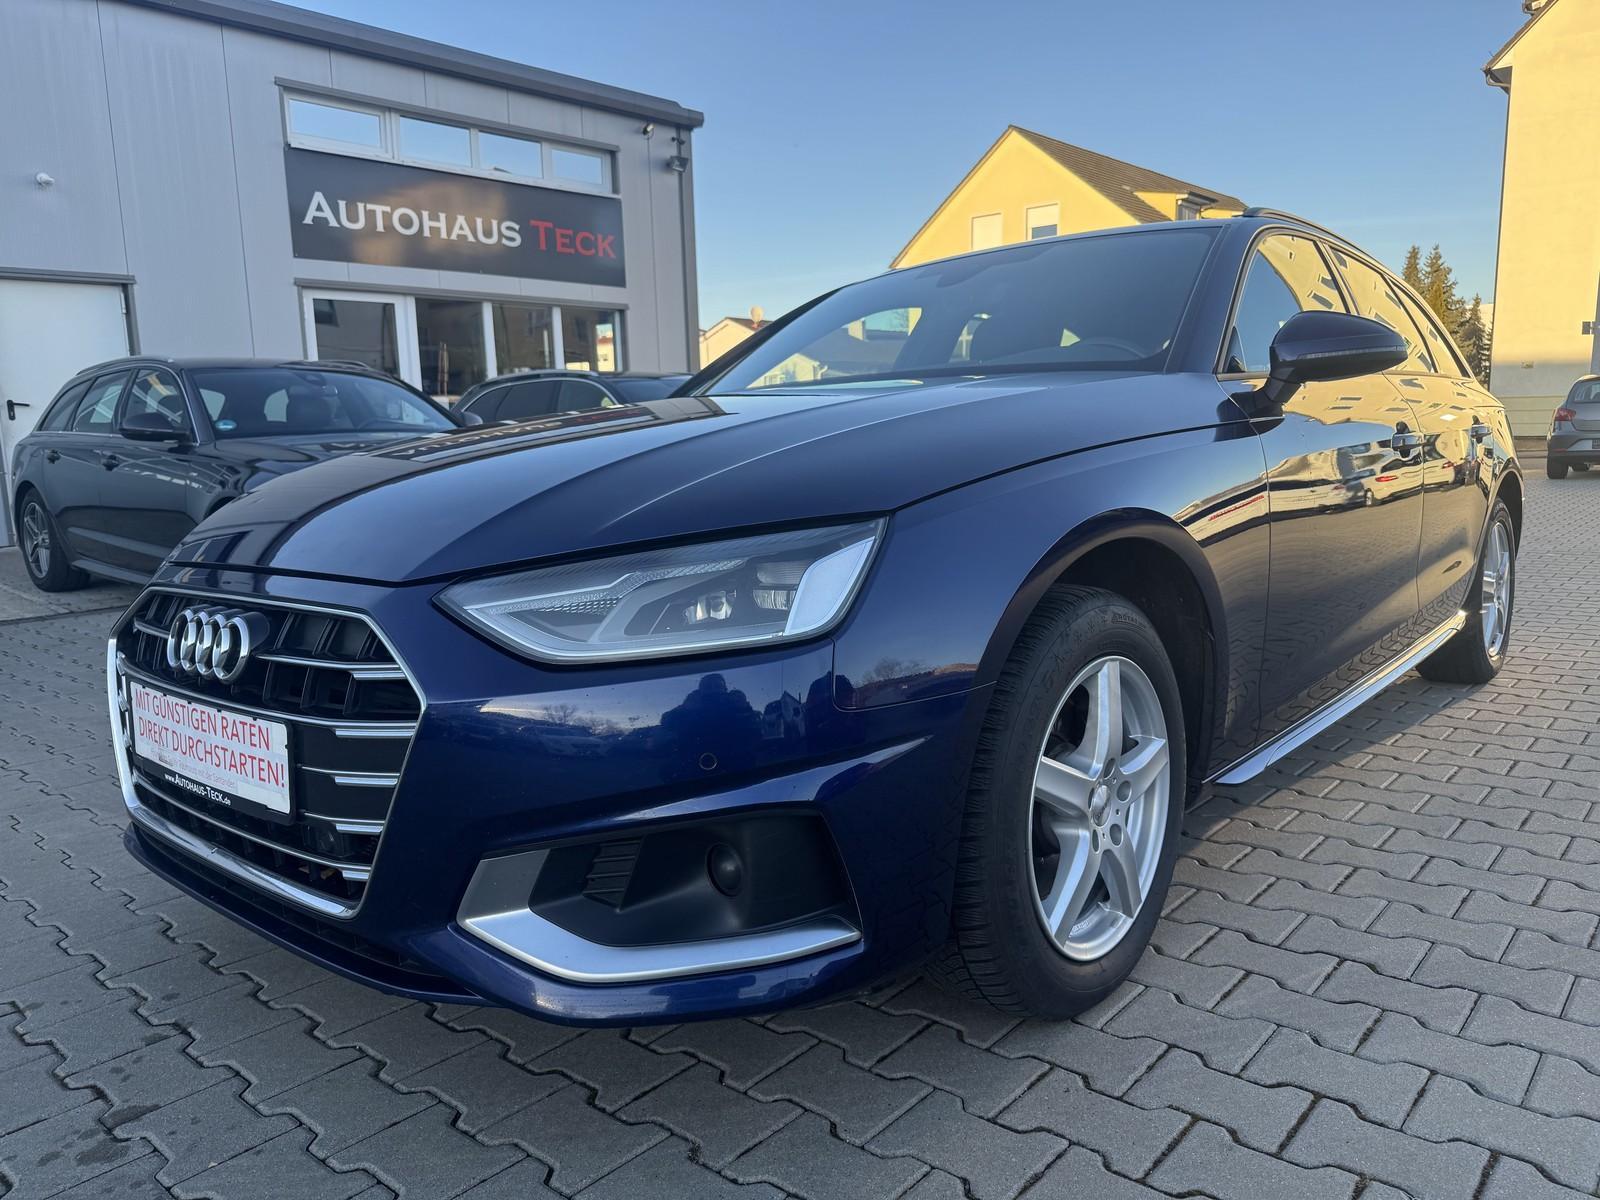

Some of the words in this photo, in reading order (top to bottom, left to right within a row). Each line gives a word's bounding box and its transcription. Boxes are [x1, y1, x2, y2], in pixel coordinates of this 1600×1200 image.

[302, 191, 522, 248] AUTOHAUS
[529, 219, 617, 259] TECK
[135, 688, 151, 711] MIT
[152, 694, 218, 737] GÜNSTIGEN
[221, 716, 271, 751] RATEN
[138, 716, 170, 748] DIREKT
[172, 730, 286, 788] DURCHSTARTEN!
